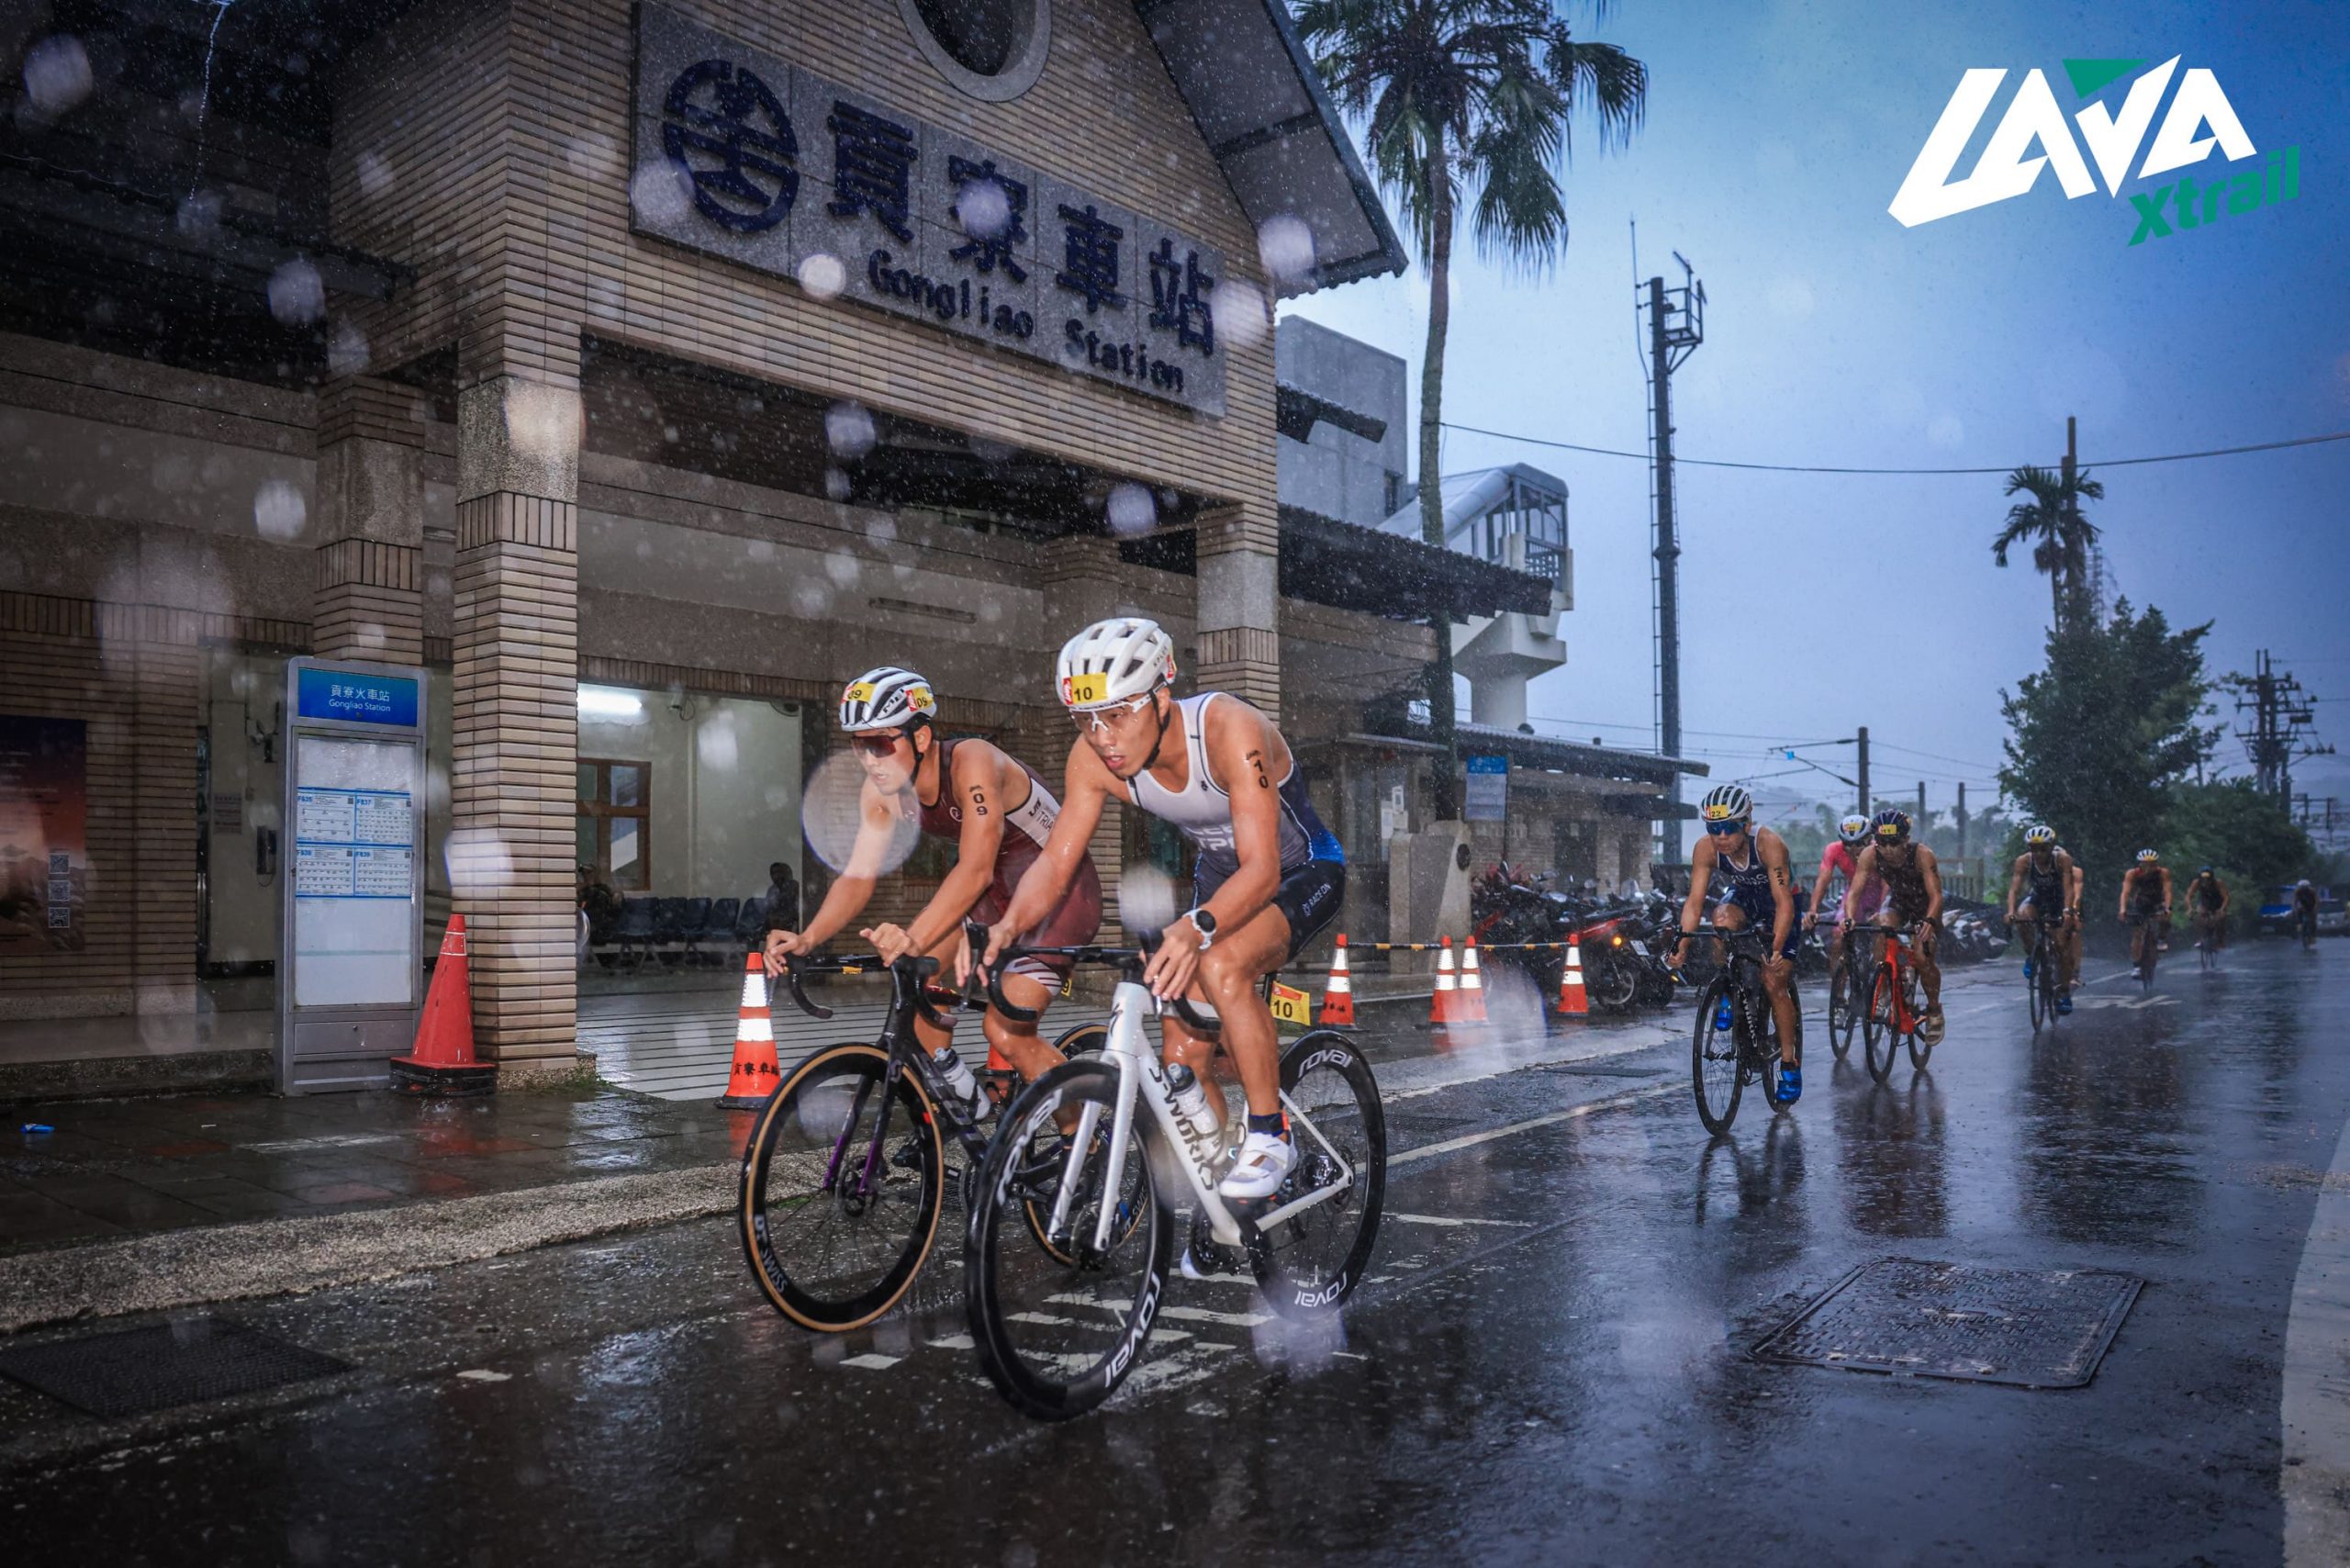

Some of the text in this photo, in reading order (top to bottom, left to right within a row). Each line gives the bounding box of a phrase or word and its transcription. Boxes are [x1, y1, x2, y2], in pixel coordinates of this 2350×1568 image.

[868, 249, 1184, 393] Gongliao Station
[330, 684, 390, 701] 貢寮火車站
[916, 697, 928, 708] 09
[1074, 687, 1092, 700] 10
[329, 699, 391, 711] Gongliao Station
[1254, 760, 1268, 789] 10
[973, 793, 988, 815] 09
[1273, 1000, 1292, 1018] 10
[1297, 1049, 1353, 1079] roval
[1294, 1271, 1347, 1307] roval
[1104, 1271, 1160, 1388] roval
